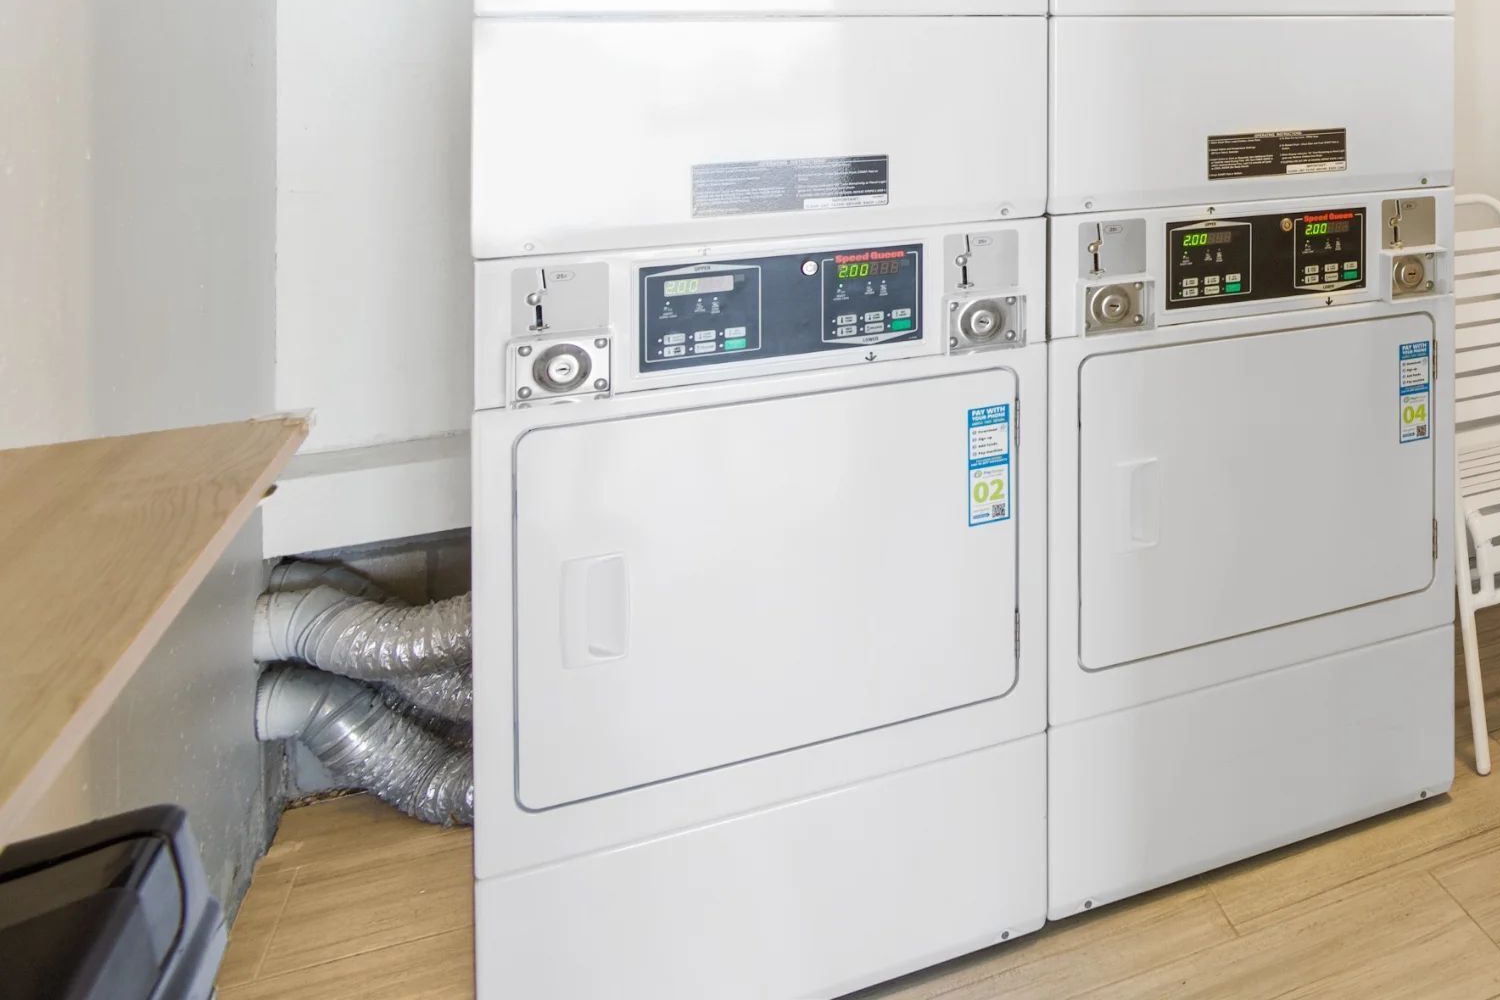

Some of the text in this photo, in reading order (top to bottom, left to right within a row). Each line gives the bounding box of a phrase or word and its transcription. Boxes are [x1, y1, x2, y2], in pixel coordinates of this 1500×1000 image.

[1304, 214, 1328, 222] Speed
[1305, 223, 1327, 235] 2.00
[1183, 233, 1208, 246] 2.00
[835, 251, 904, 263] Speed Queen
[838, 264, 869, 278] 2.00
[986, 406, 1005, 414] WITH
[1403, 404, 1426, 424] 04
[974, 479, 1005, 503] 02
